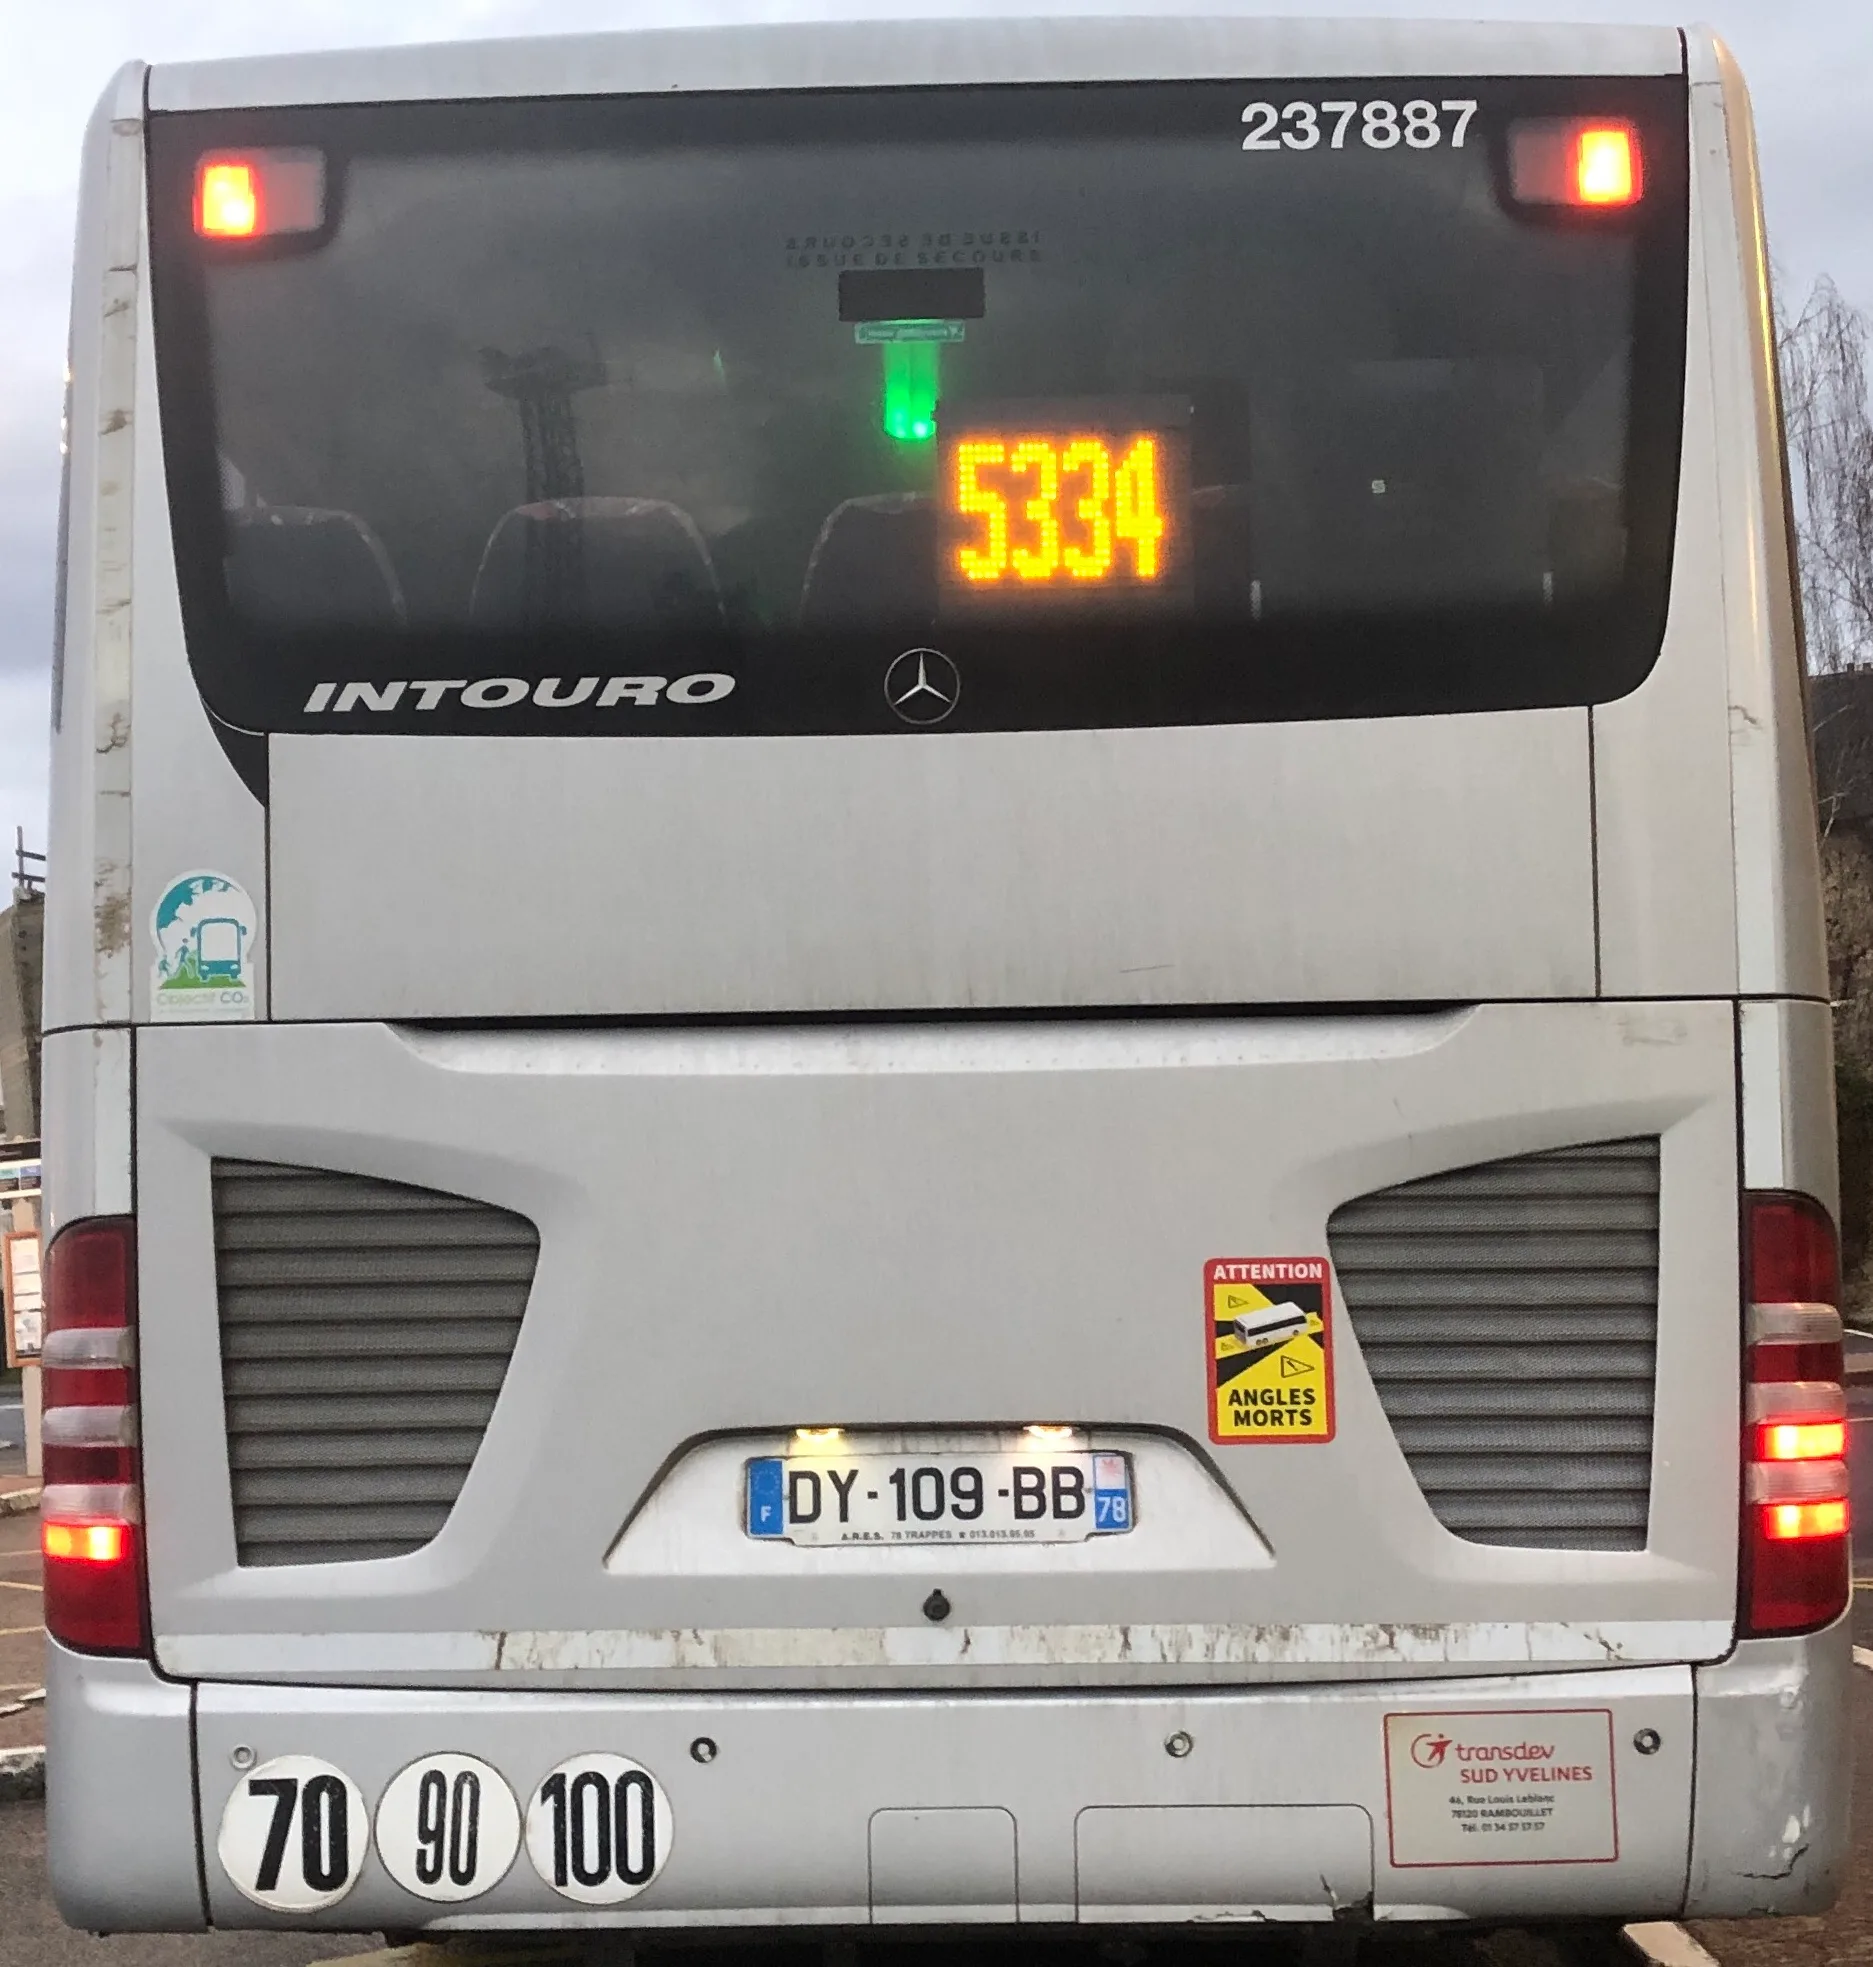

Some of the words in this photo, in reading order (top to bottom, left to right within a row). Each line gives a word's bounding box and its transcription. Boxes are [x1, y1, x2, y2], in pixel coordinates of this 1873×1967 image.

[1241, 99, 1478, 150] 237887
[957, 439, 1164, 580] 5334
[303, 672, 737, 713] INTOURO
[1213, 1262, 1323, 1281] ATTENTION
[1227, 1387, 1316, 1407] ANGLES
[1233, 1408, 1313, 1428] MORTS
[760, 1506, 772, 1522] F
[1096, 1496, 1128, 1524] 78
[905, 1529, 953, 1540] TRAPPES
[1454, 1741, 1556, 1762] transdev
[1460, 1768, 1499, 1784] SUD
[1503, 1765, 1593, 1783] YVELINES
[1480, 1807, 1554, 1818] RAMBOUILLET
[248, 1774, 350, 1892] 70
[415, 1769, 481, 1887] 90
[540, 1769, 656, 1888] 100
